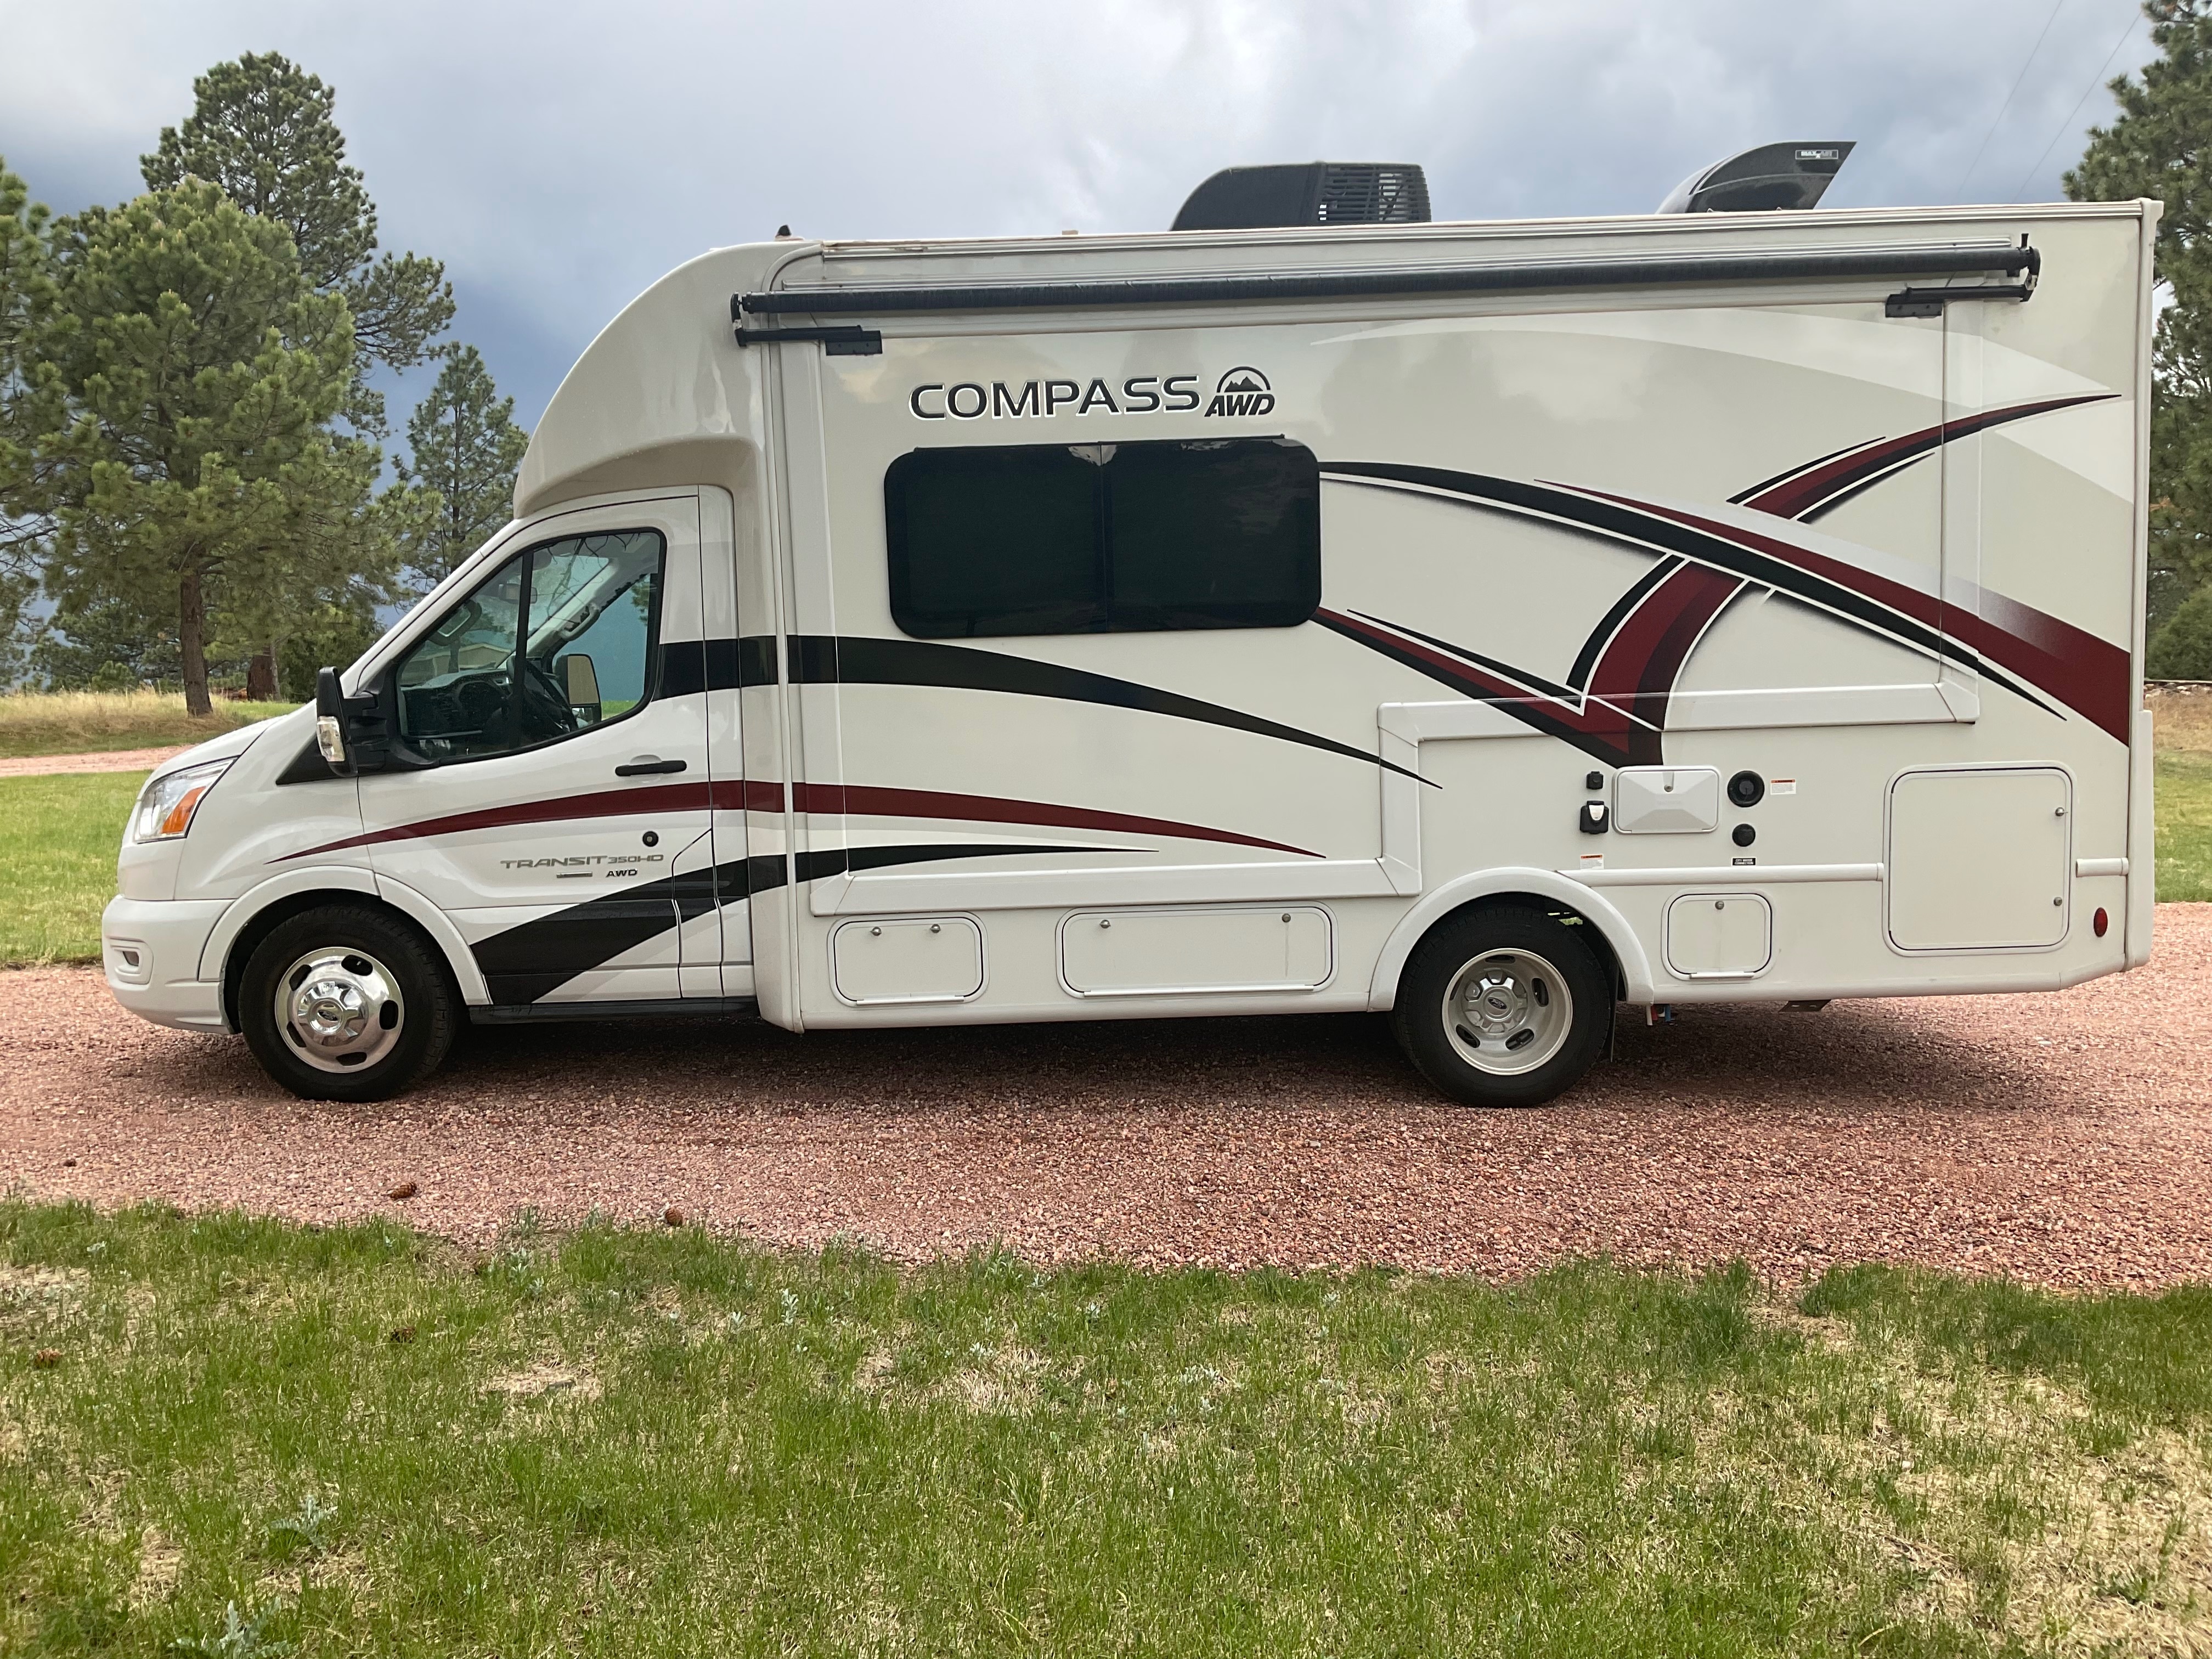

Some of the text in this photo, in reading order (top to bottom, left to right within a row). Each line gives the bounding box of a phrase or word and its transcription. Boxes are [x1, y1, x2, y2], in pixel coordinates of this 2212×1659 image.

[909, 375, 1275, 421] COMPASS AWD
[500, 854, 664, 869] TRANSIT 350HD
[606, 868, 637, 878] AWD
